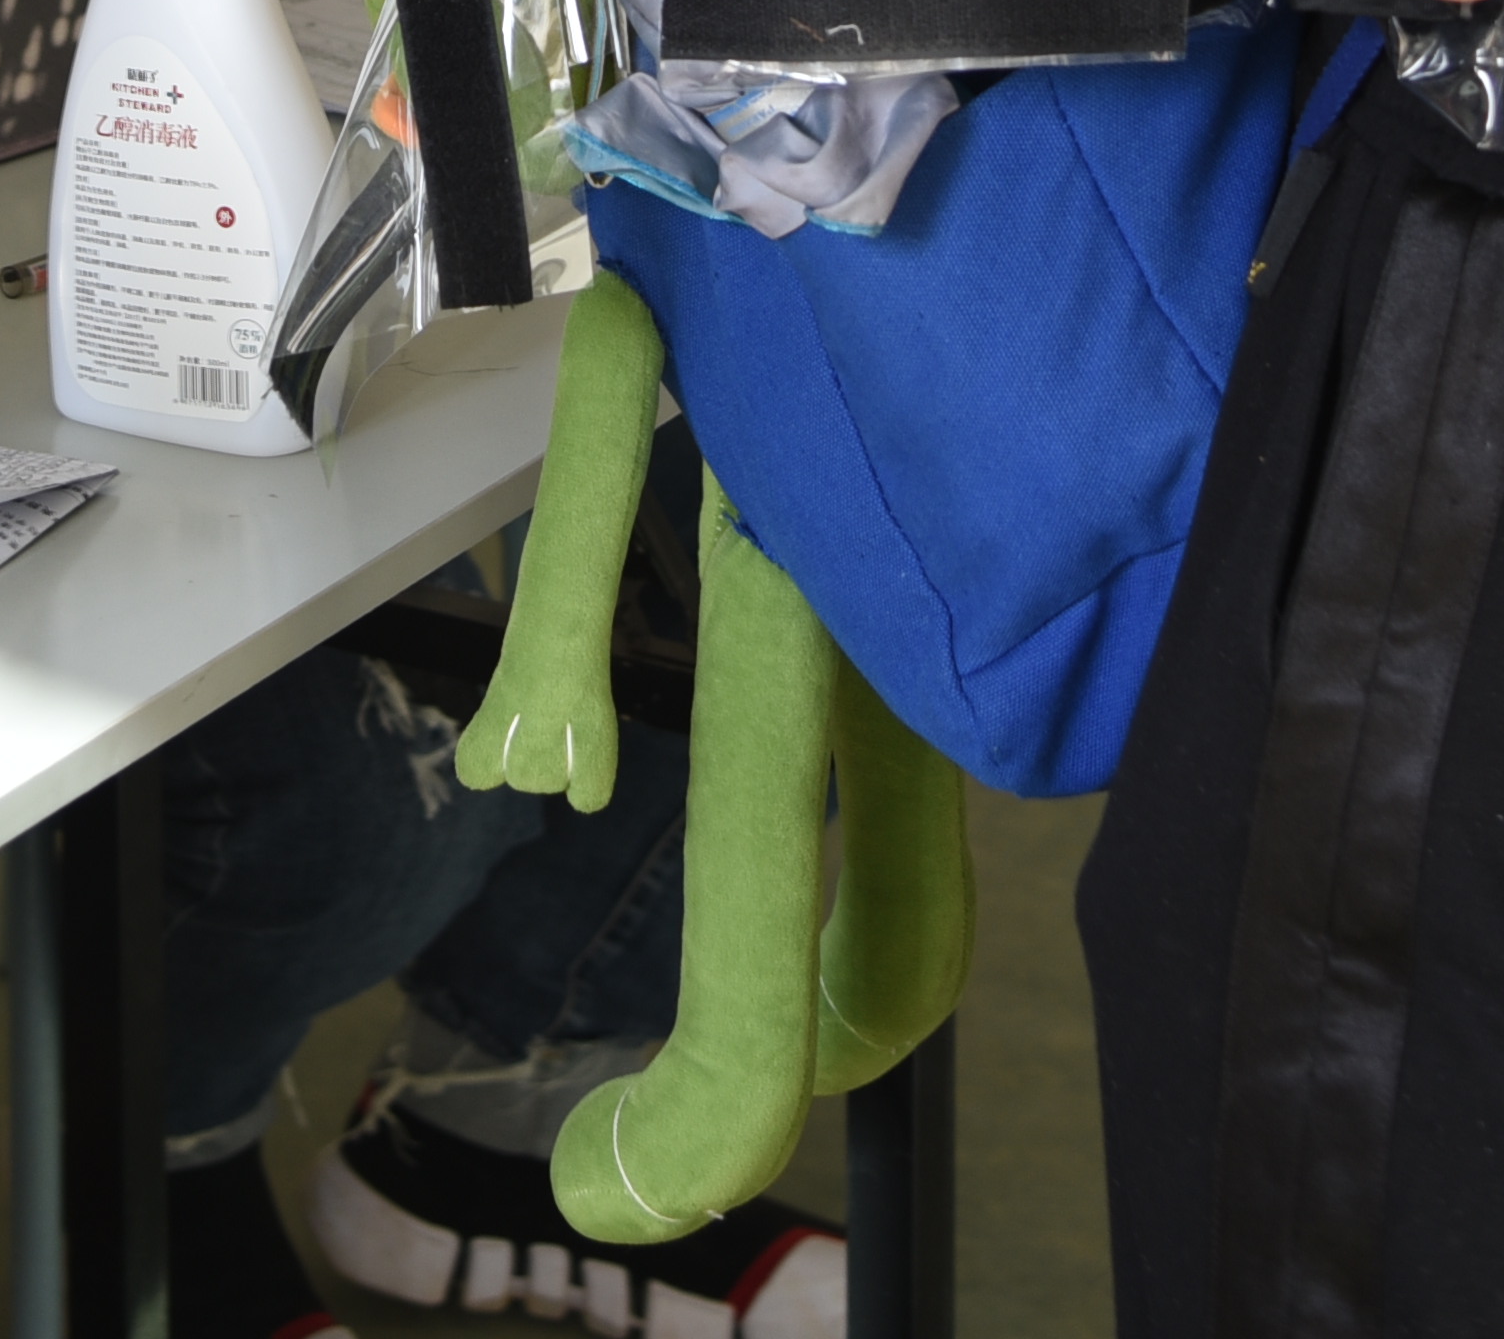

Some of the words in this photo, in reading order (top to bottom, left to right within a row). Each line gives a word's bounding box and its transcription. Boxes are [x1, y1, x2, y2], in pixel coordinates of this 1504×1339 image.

[95, 113, 199, 150] 乙醇消毒液
